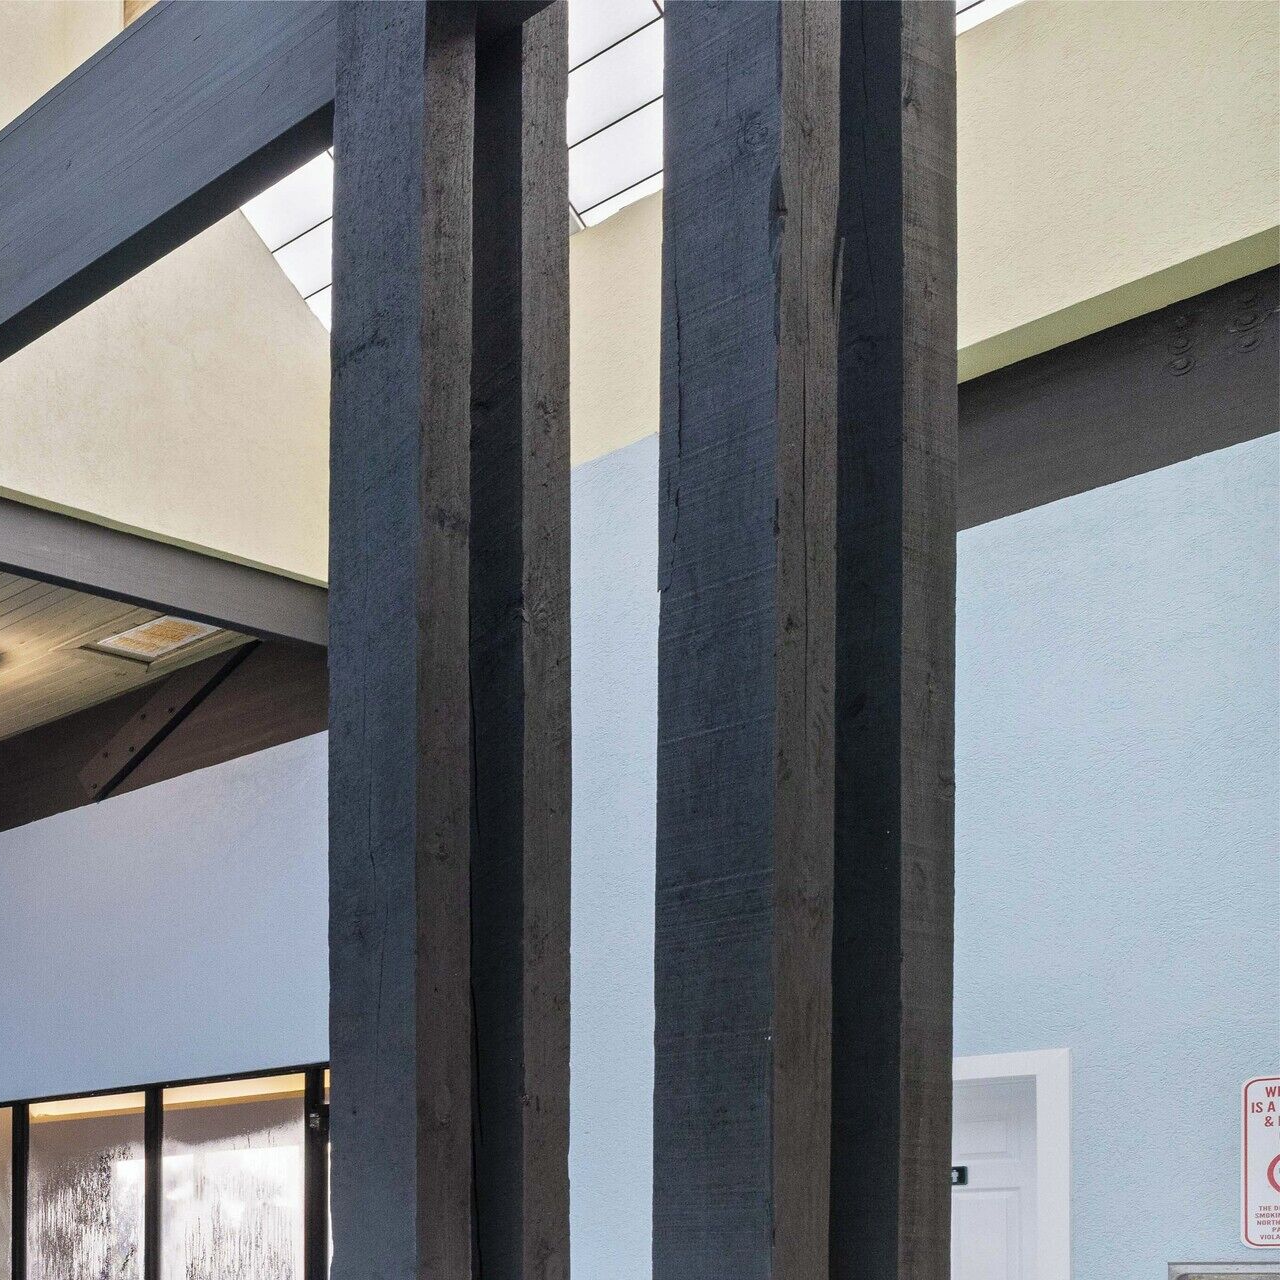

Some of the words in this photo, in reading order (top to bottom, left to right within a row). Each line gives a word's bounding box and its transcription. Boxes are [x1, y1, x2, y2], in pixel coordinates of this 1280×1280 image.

[1251, 1102, 1263, 1113] IS
[1268, 1101, 1276, 1112] A
[1264, 1115, 1274, 1127] &
